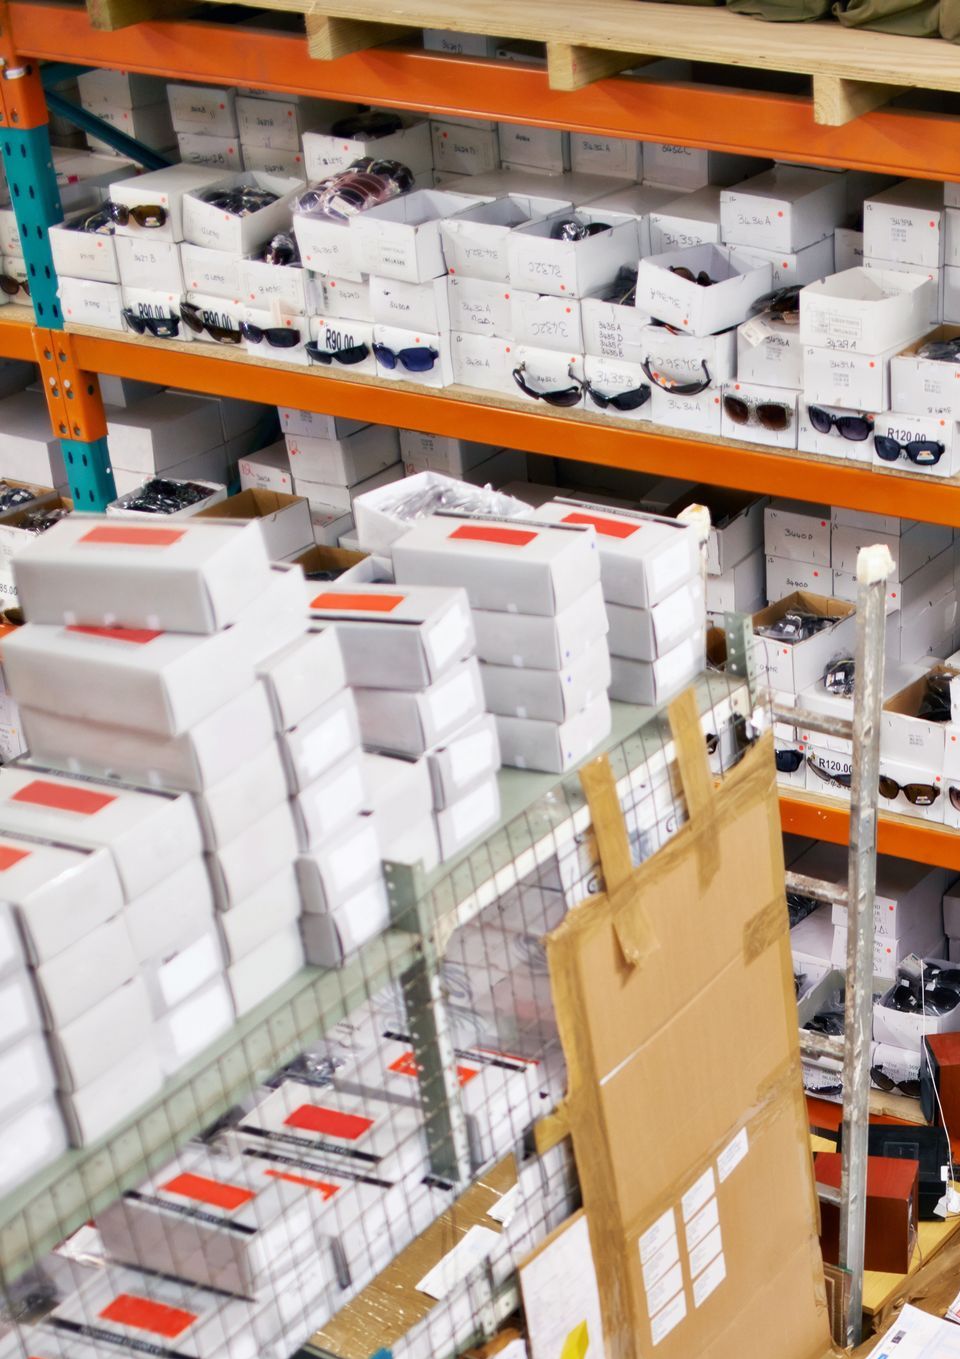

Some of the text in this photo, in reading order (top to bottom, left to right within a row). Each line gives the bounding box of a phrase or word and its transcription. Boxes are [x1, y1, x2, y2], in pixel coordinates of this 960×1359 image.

[138, 302, 164, 319] R9000
[203, 311, 232, 330] R9000
[325, 328, 354, 351] R9000
[887, 427, 927, 443] R12000
